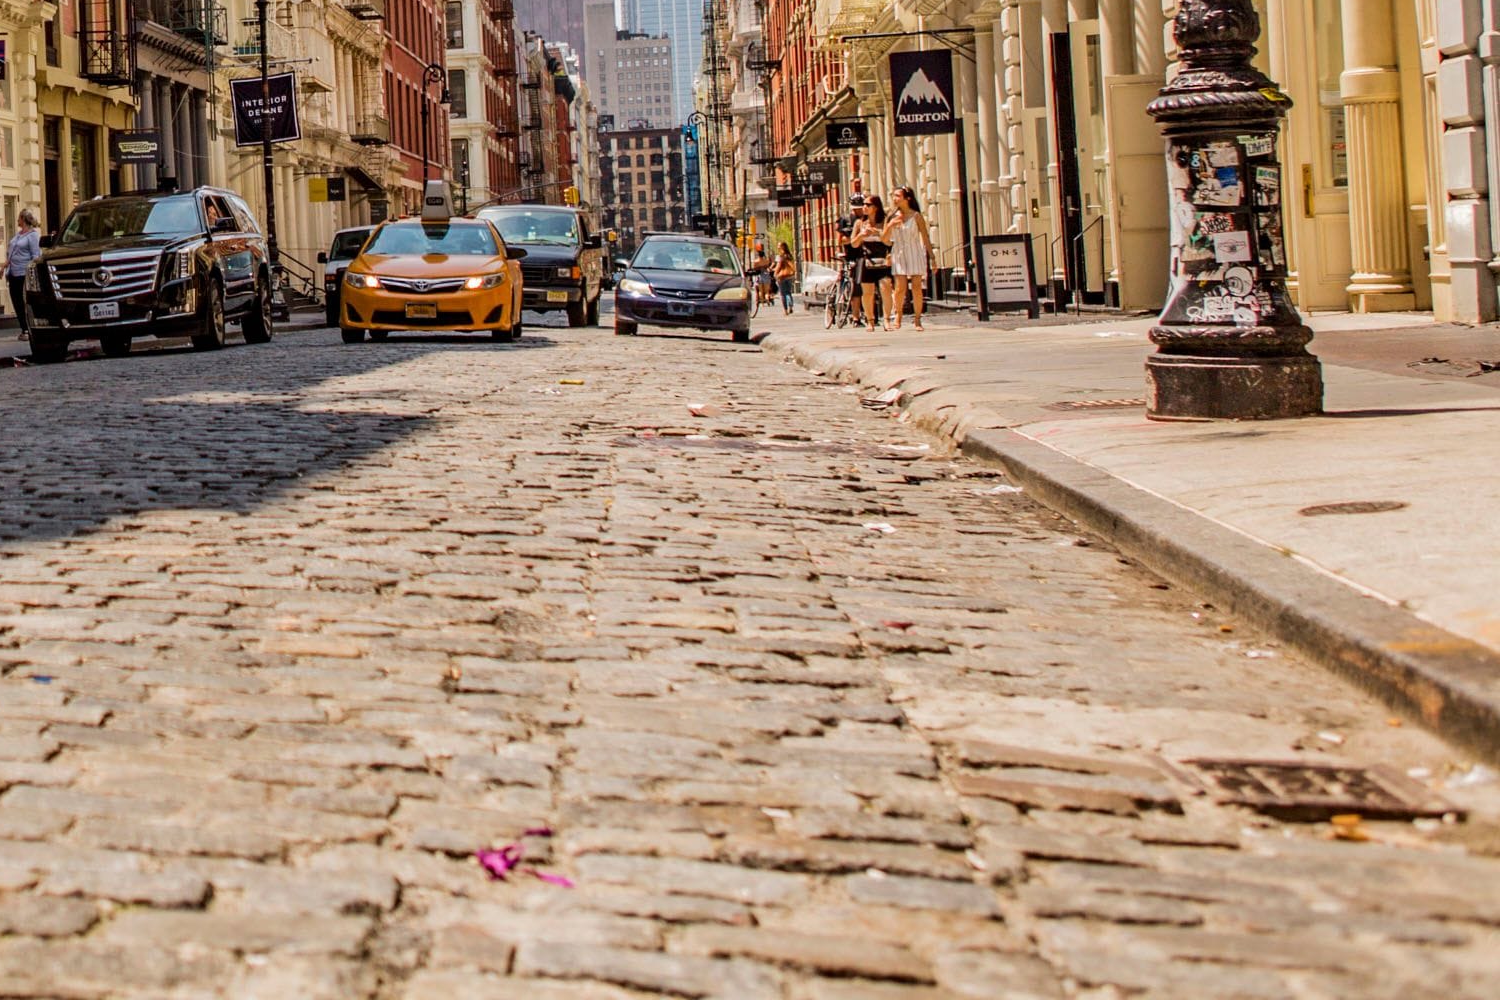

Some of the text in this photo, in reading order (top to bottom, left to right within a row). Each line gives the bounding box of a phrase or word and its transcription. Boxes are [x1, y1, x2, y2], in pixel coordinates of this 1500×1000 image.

[242, 95, 287, 107] INTEIOR
[248, 105, 283, 117] DENE
[899, 111, 950, 123] BURTON
